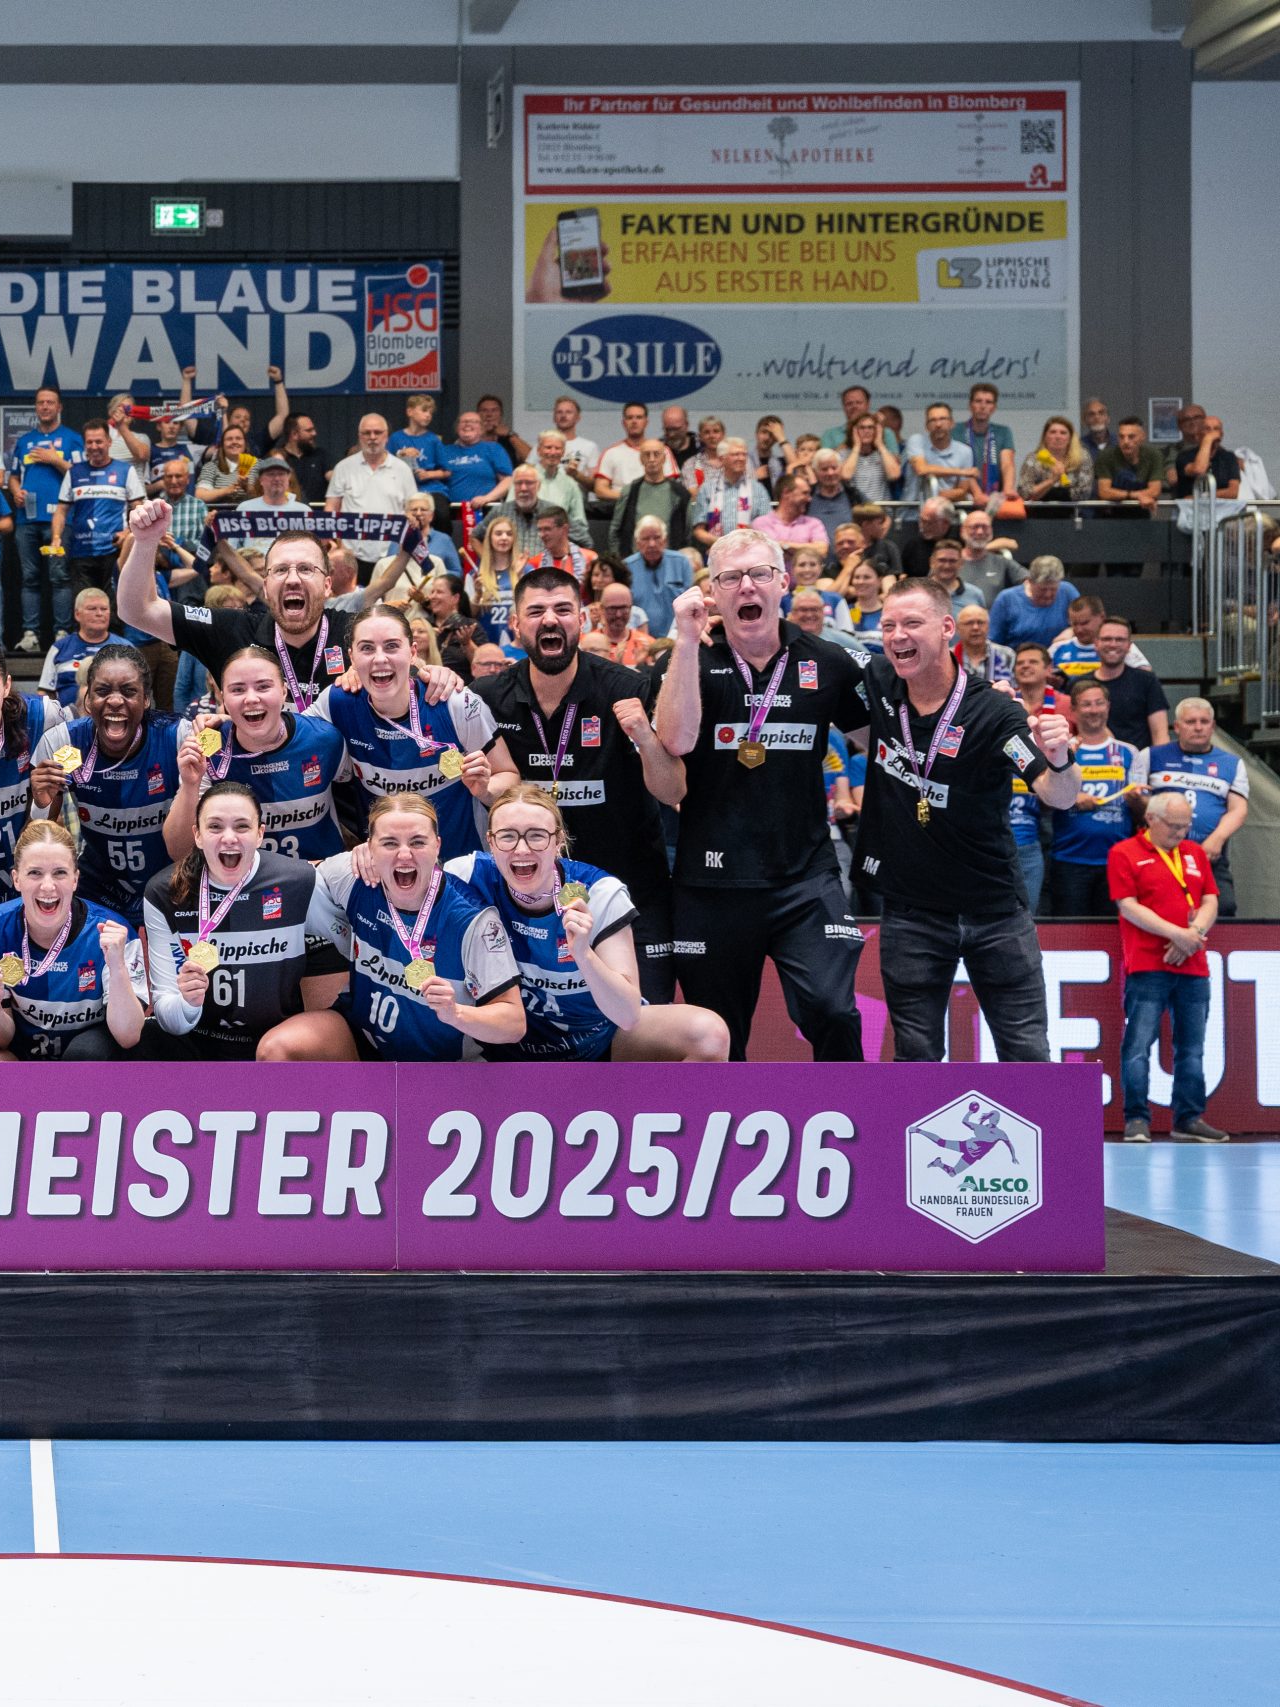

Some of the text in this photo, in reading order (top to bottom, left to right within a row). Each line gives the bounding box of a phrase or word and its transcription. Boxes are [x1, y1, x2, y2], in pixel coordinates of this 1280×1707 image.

[564, 95, 1026, 112] Ihr Partner für Gesundheit und Wohlbefinden in Blomberg
[712, 147, 875, 164] NELKEN APOTHEKE
[621, 206, 1045, 236] FAKTEN UND HINTERGRÜNDE
[621, 239, 896, 265] ERFAHREN SIE BEI UNS
[985, 256, 1051, 268] LIPPISCHE
[656, 269, 896, 294] AUS ERSTER HAND.
[985, 267, 1051, 279] LANDES
[985, 278, 1051, 289] ZEITUNG
[132, 269, 357, 315] BLAUE
[366, 291, 438, 333] HSG
[366, 333, 438, 354] Blomberg
[366, 349, 406, 370] Lippe
[556, 333, 720, 382] DIE BRILLE
[930, 344, 1041, 380] anders!
[367, 370, 439, 390] handball
[218, 516, 403, 536] HSG BLOMBERG-LIPPE
[366, 773, 446, 795] Lippische
[94, 811, 167, 833] Lippisch
[107, 841, 146, 872] 55
[705, 851, 724, 869] RK
[645, 943, 673, 955] BIND
[213, 969, 246, 1008] 61
[370, 991, 399, 1033] 10
[421, 1110, 856, 1219] 2025/26
[958, 1175, 1029, 1193] ALSCO
[919, 1195, 1029, 1205] HANDBALL BUNDESLIGA
[956, 1207, 993, 1217] FRAUEN
